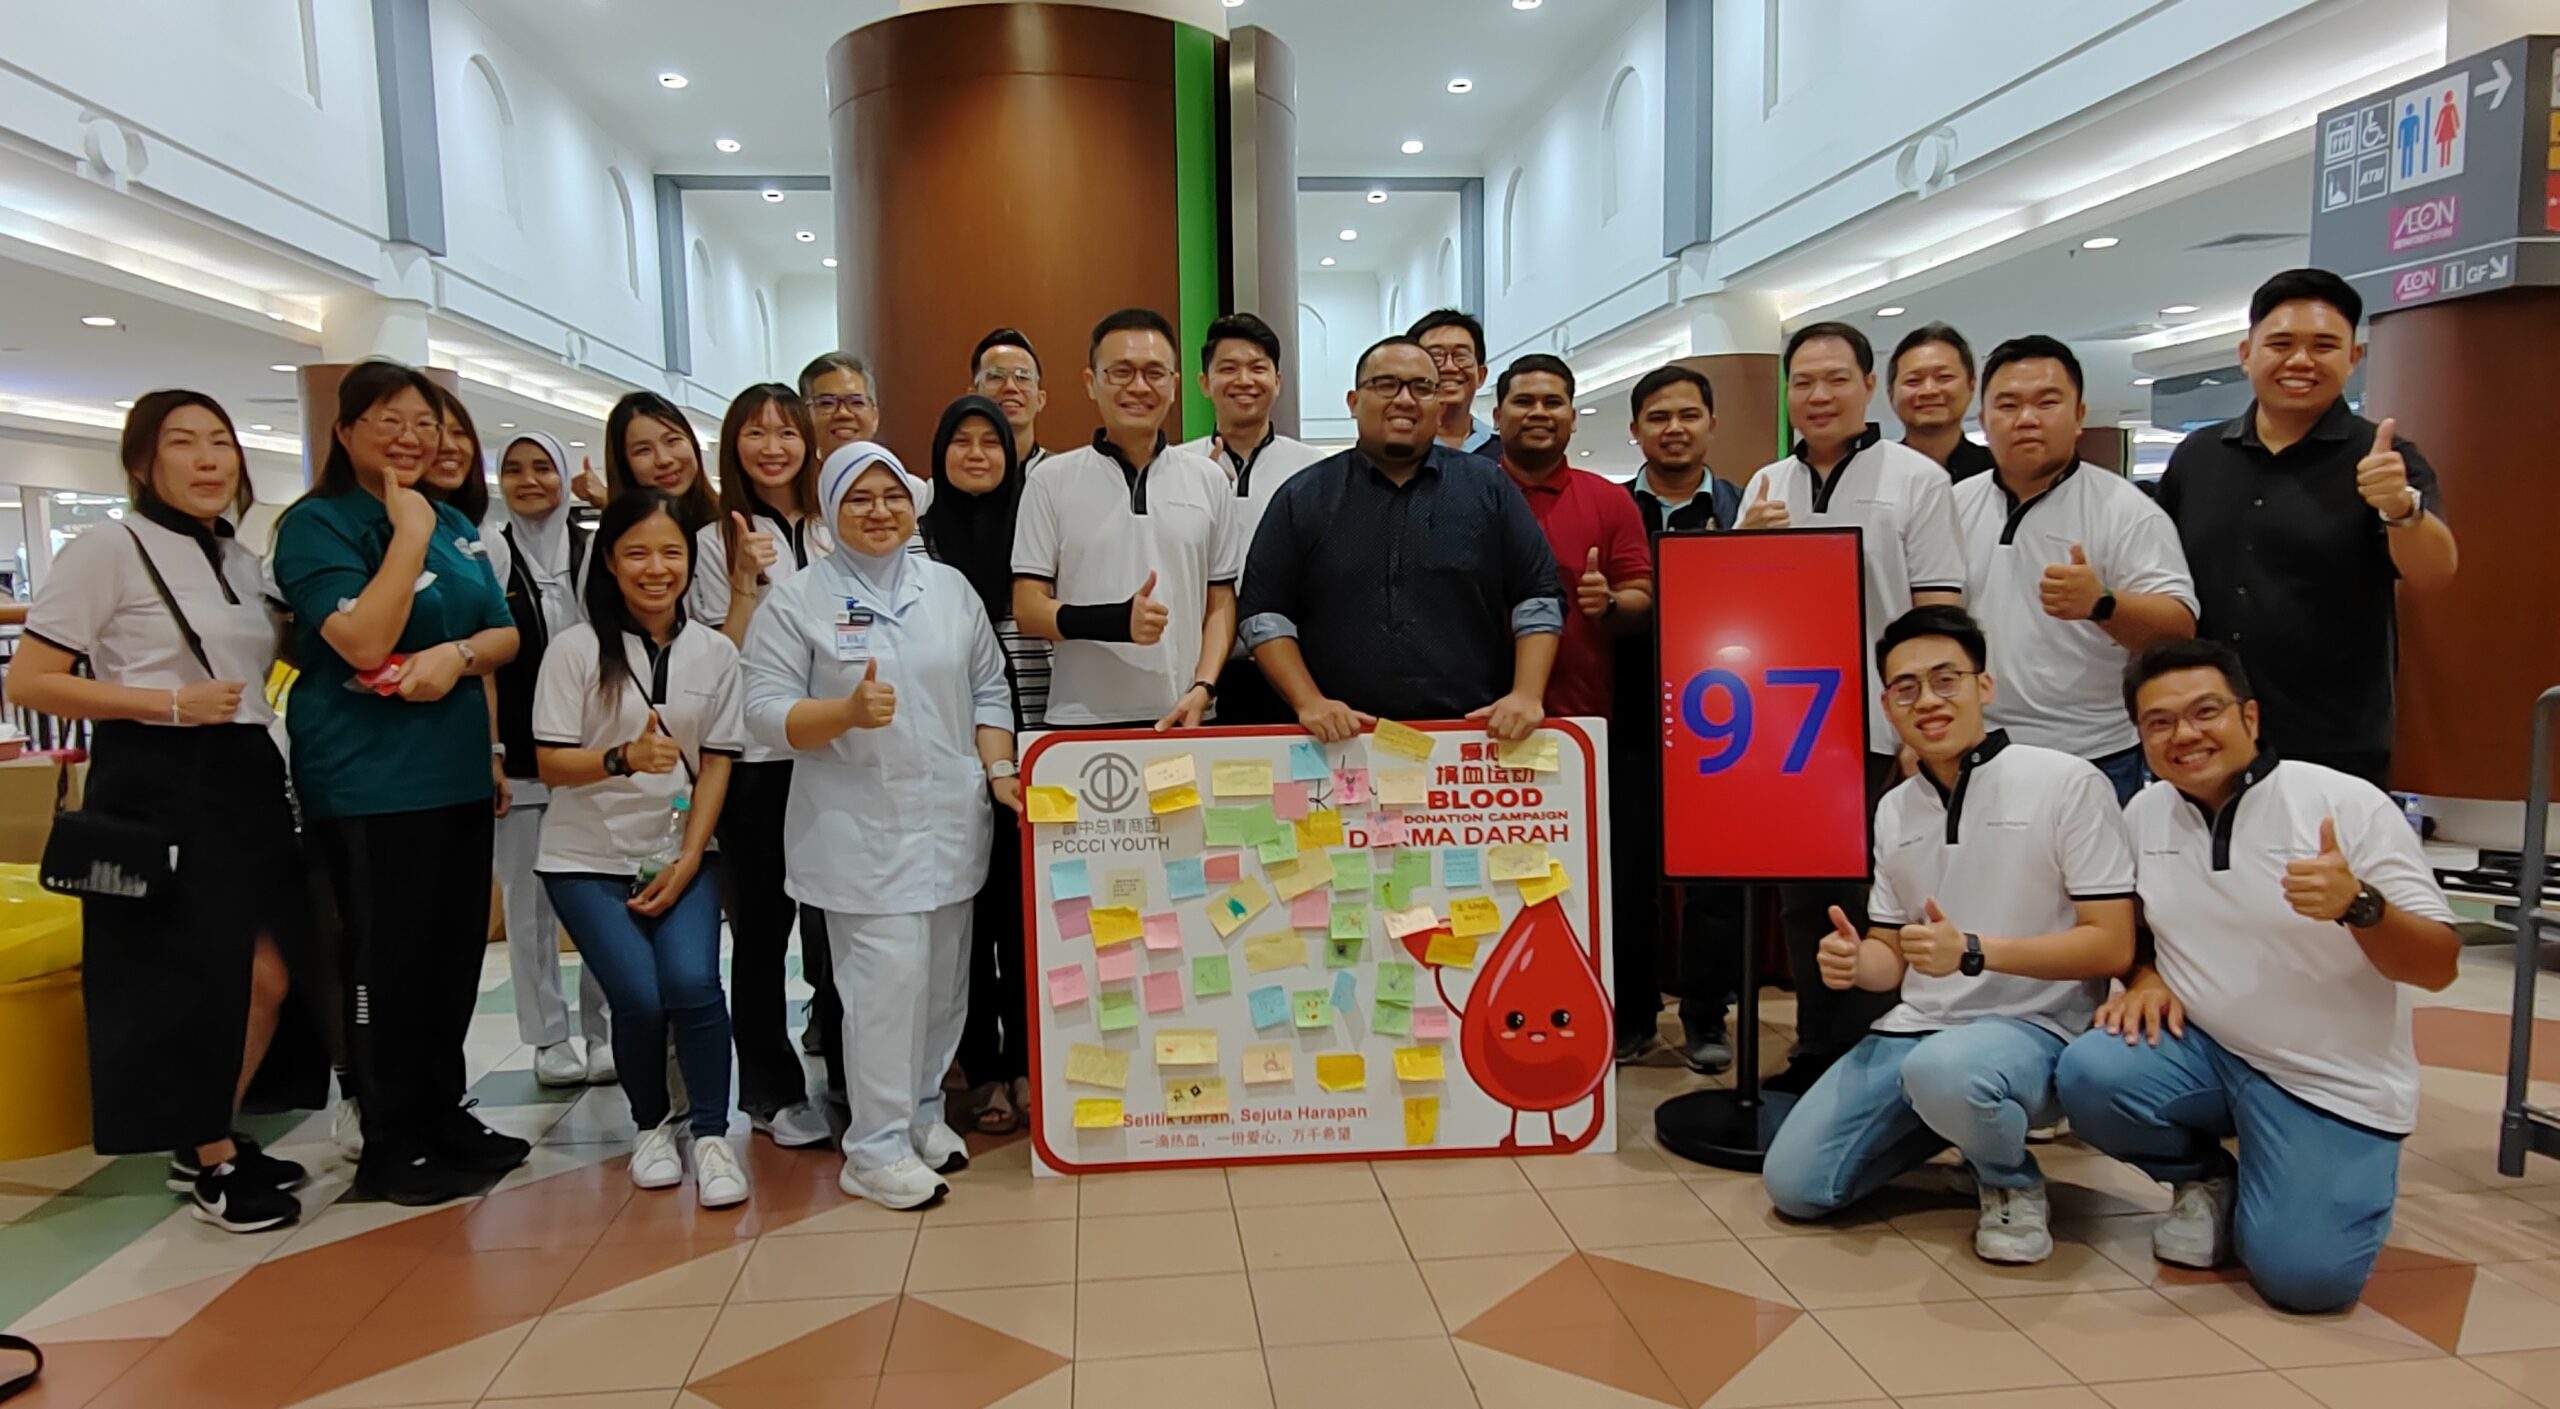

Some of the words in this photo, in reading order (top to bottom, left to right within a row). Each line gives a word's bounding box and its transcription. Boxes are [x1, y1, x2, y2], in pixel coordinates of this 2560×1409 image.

[2359, 166, 2385, 186] ATM
[2466, 263, 2490, 284] GF
[1681, 667, 1842, 775] 97
[1427, 787, 1543, 810] BLOOD
[1404, 814, 1483, 825] DONATION
[1488, 810, 1568, 823] CAMPAIGN
[1052, 837, 1106, 855] PCCCI
[1110, 835, 1170, 853] YOUTH
[1349, 826, 1457, 849] DMA
[1464, 823, 1569, 846] DARAH
[1241, 1107, 1293, 1124] Sejuta
[1298, 1105, 1368, 1123] Harapan
